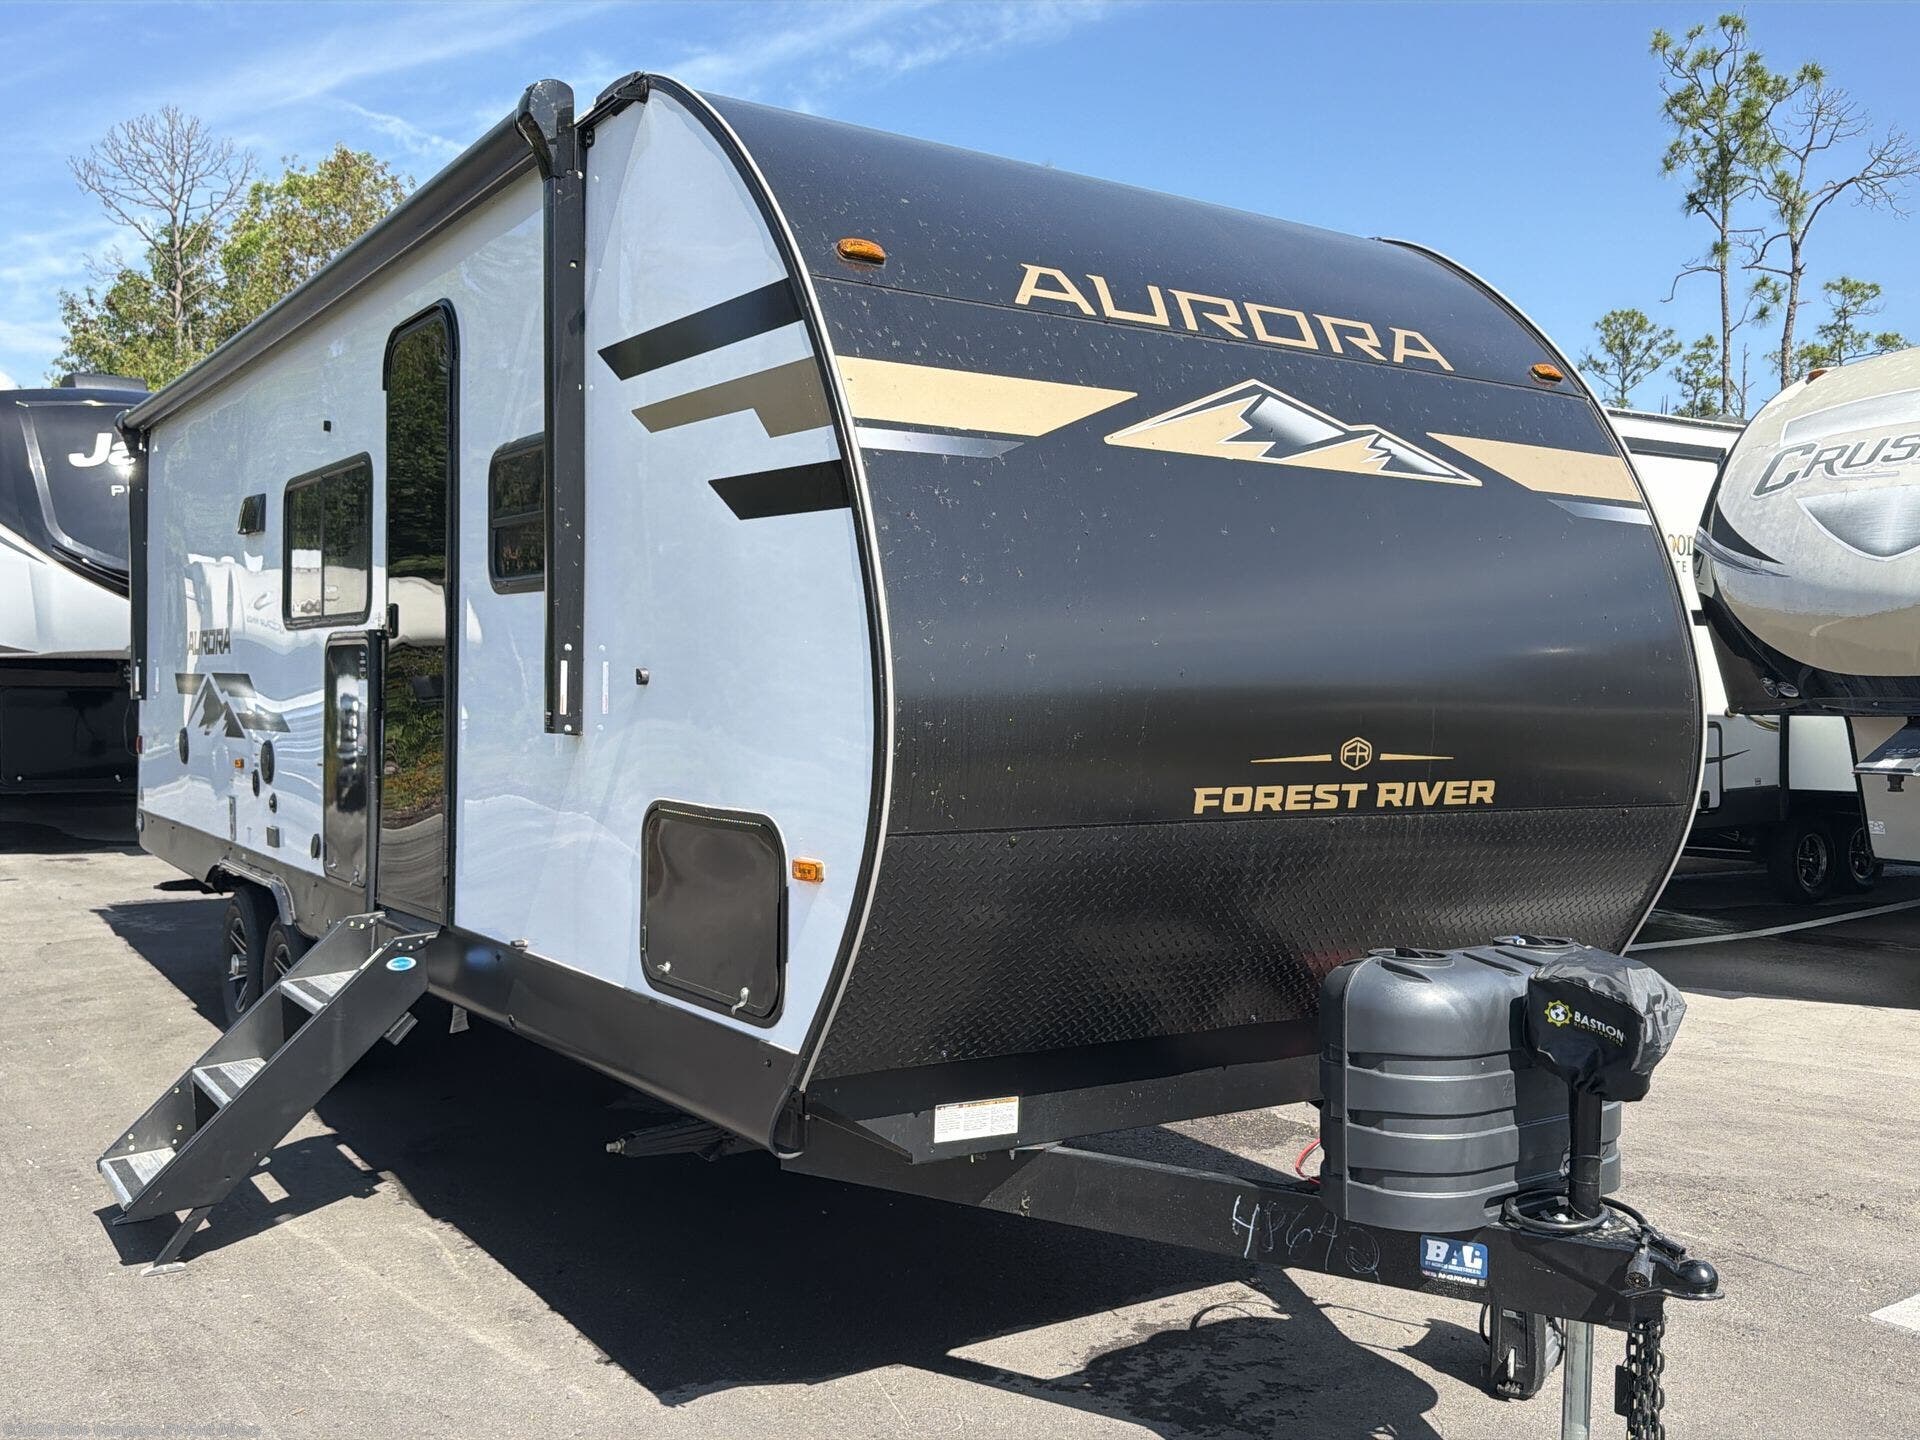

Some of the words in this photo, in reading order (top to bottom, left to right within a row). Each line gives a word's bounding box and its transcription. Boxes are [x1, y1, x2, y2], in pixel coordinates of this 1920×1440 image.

[1014, 262, 1455, 372] AURORA
[188, 627, 231, 656] AURORA
[1193, 782, 1369, 814] FOREST
[1376, 779, 1496, 808] RIVER
[1574, 1011, 1625, 1043] BASTION
